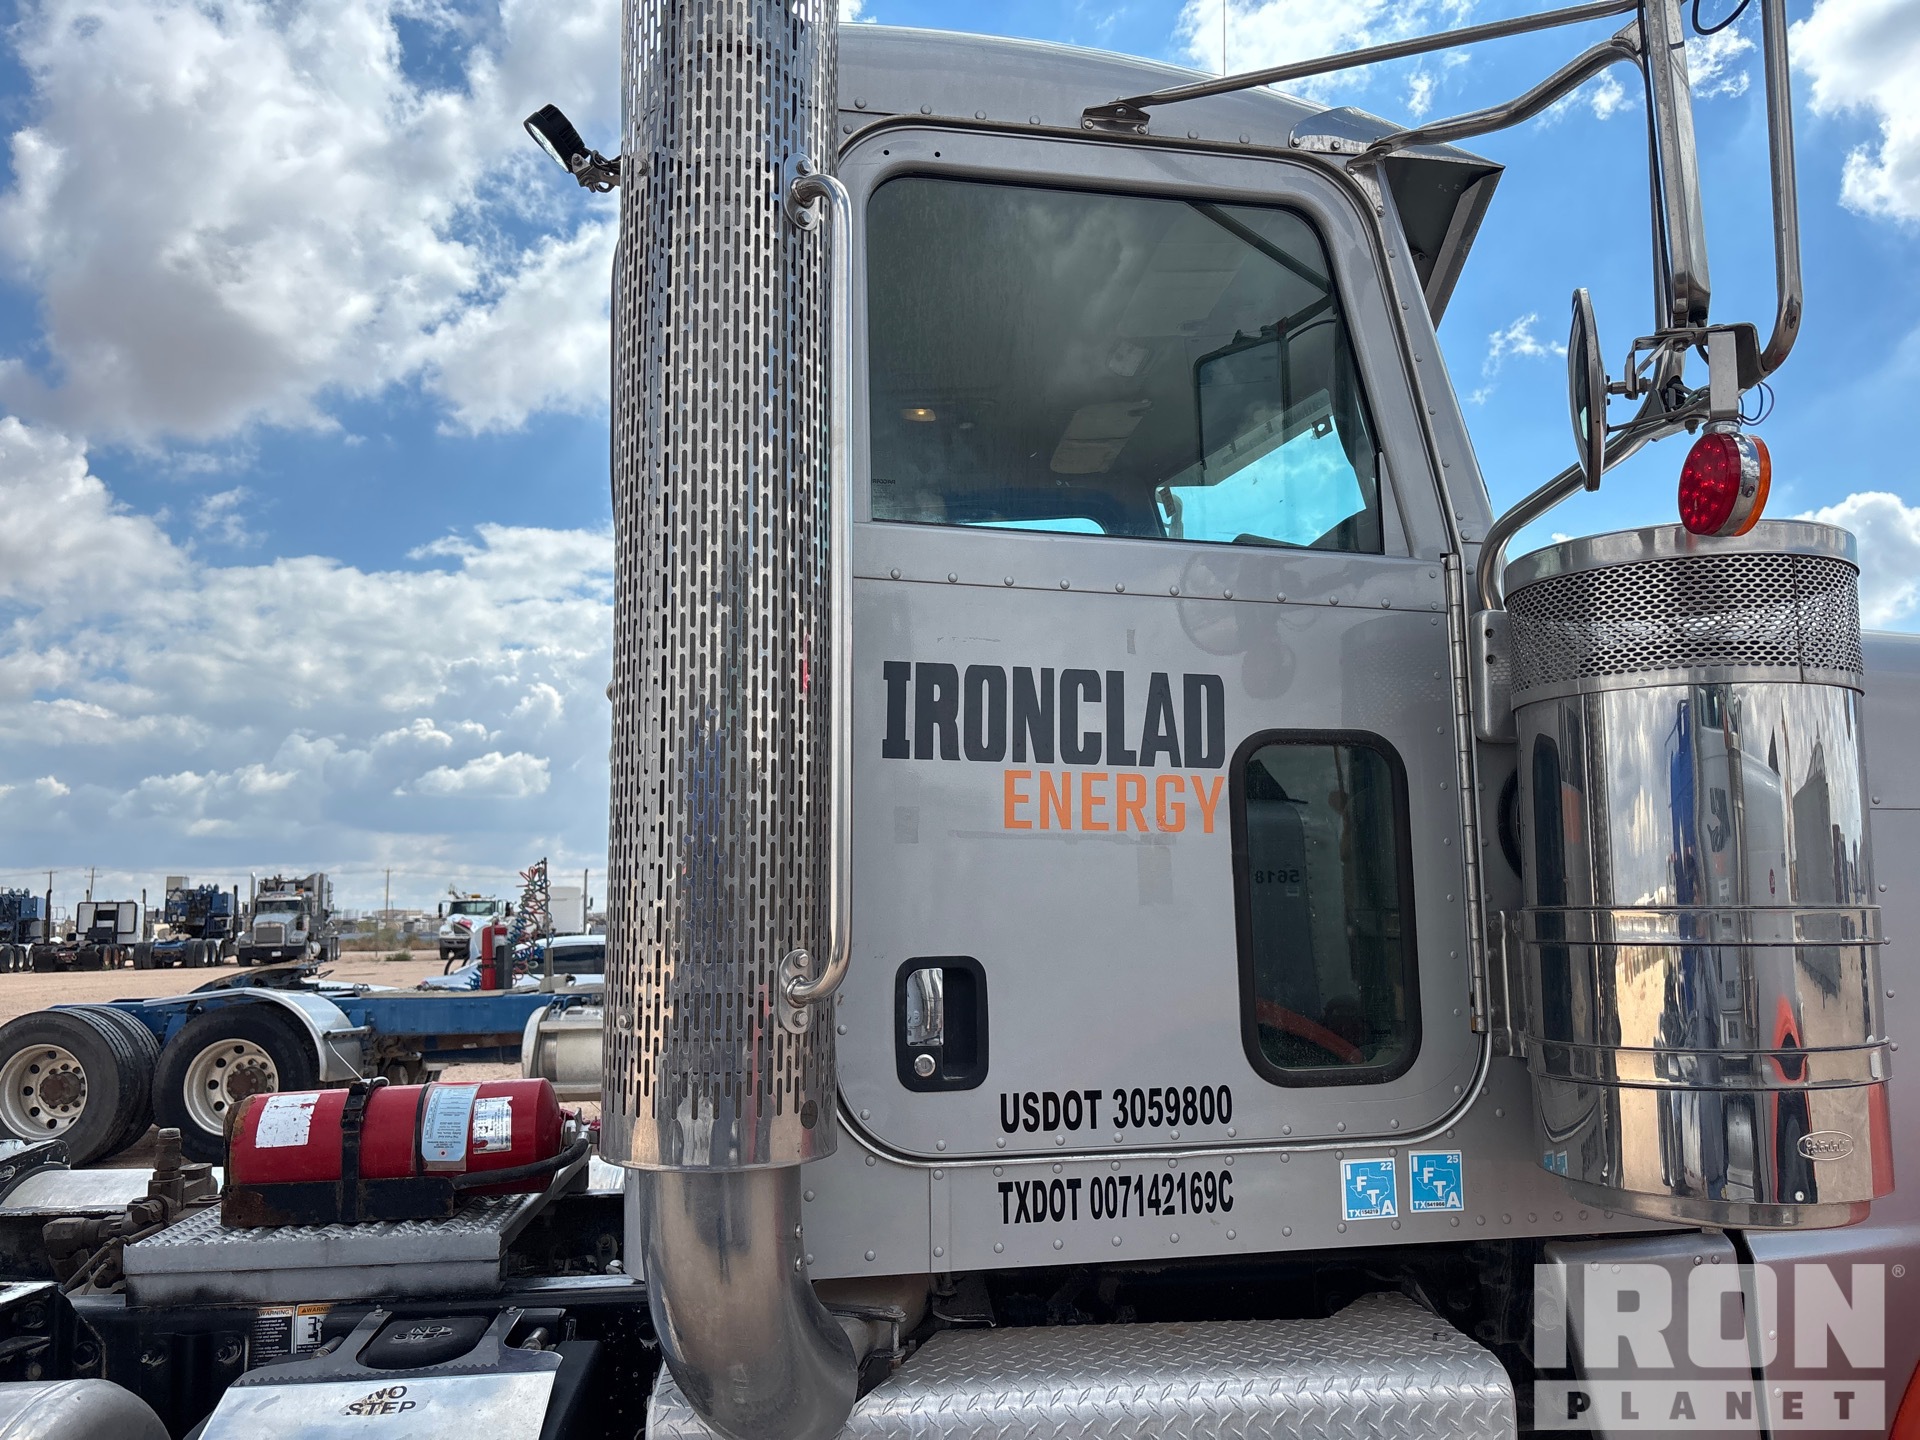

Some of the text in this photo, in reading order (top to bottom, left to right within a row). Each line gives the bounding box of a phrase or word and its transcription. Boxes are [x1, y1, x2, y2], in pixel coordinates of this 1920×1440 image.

[882, 660, 1226, 769] IRONCLAD
[1004, 769, 1225, 834] ENERGY
[1000, 1084, 1233, 1134] USDOT 3059800
[1380, 1162, 1393, 1171] 22
[1446, 1155, 1459, 1164] 25
[998, 1170, 1234, 1225] TXDOT 007142169C
[1414, 1200, 1426, 1209] TX
[1349, 1209, 1360, 1218] TX
[367, 1385, 408, 1400] NO
[345, 1400, 417, 1416] STEP
